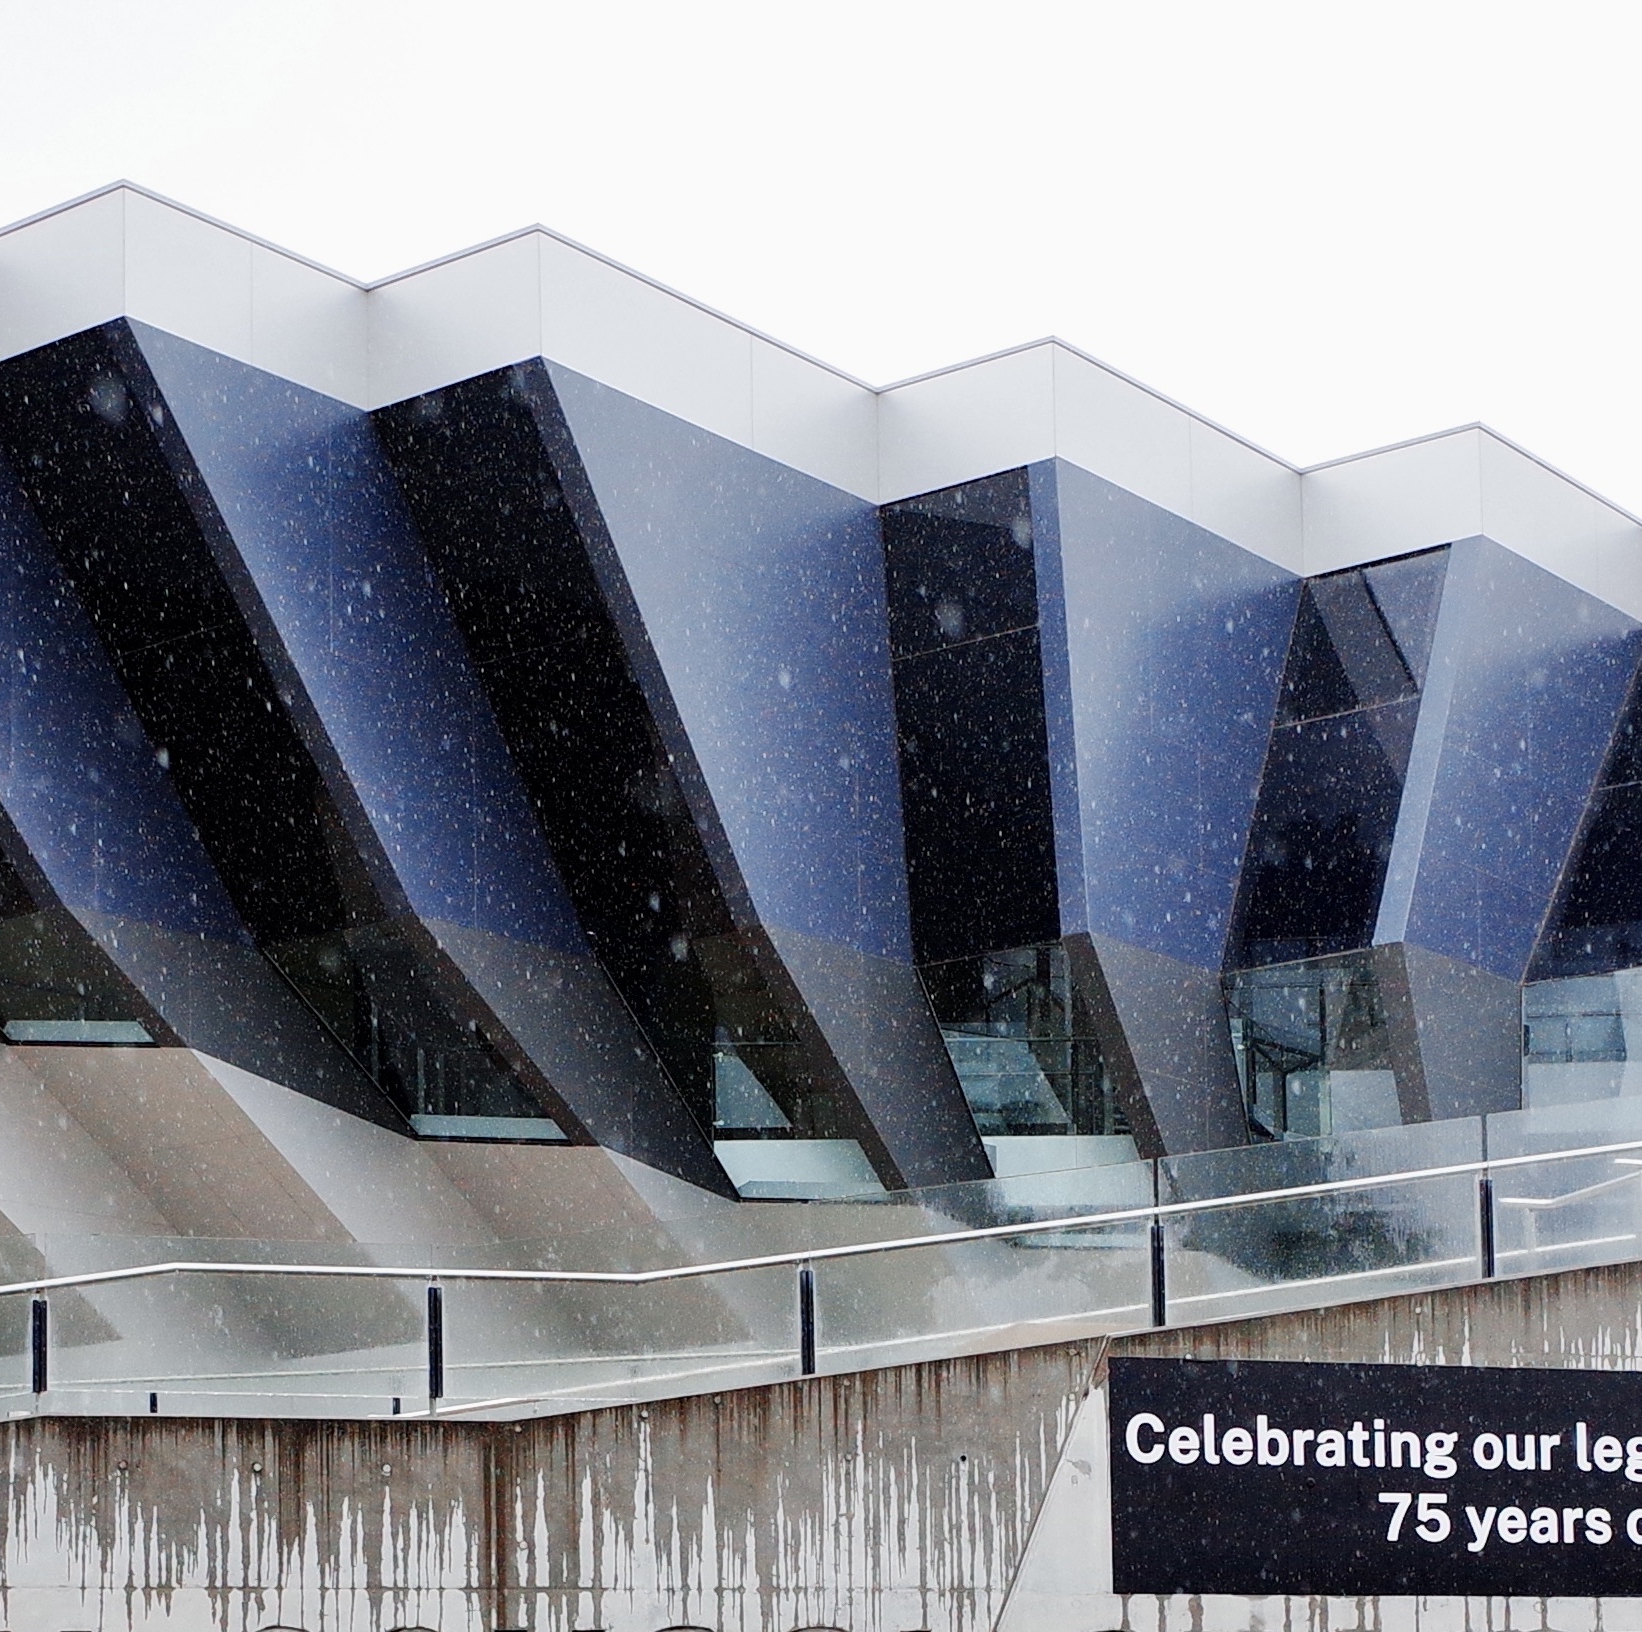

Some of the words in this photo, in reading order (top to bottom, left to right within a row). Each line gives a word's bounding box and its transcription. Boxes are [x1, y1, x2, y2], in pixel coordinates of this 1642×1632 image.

[1125, 1412, 1459, 1479] Celebrating
[1472, 1432, 1561, 1472] our
[1378, 1492, 1451, 1543] 75
[1464, 1506, 1613, 1553] years
